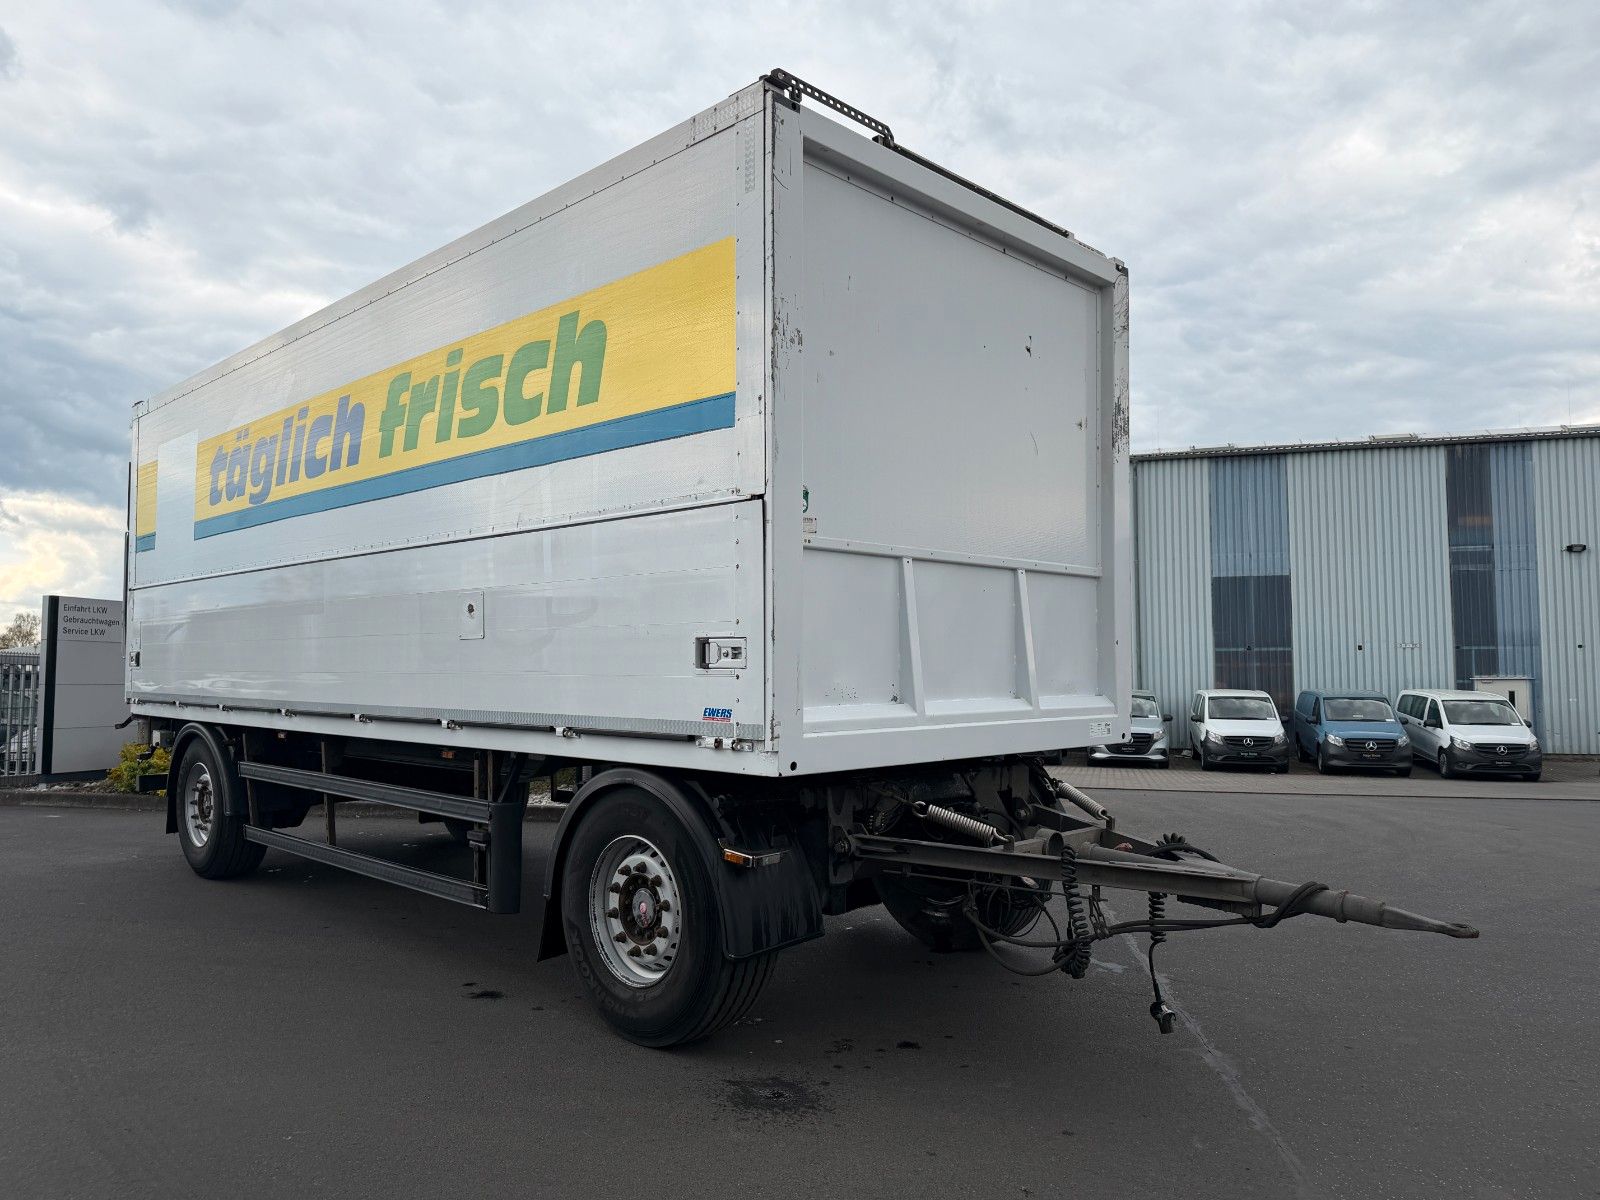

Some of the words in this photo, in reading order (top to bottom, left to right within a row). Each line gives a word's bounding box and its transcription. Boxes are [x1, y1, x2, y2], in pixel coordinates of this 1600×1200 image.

[209, 394, 365, 506] täglich
[379, 310, 608, 459] frisch
[63, 603, 91, 614] Einfahrt
[92, 605, 108, 614] LKW
[63, 615, 120, 627] Gebrauchtwagen
[62, 627, 88, 636] Service
[90, 628, 106, 636] LKW
[703, 707, 733, 718] EWERS
